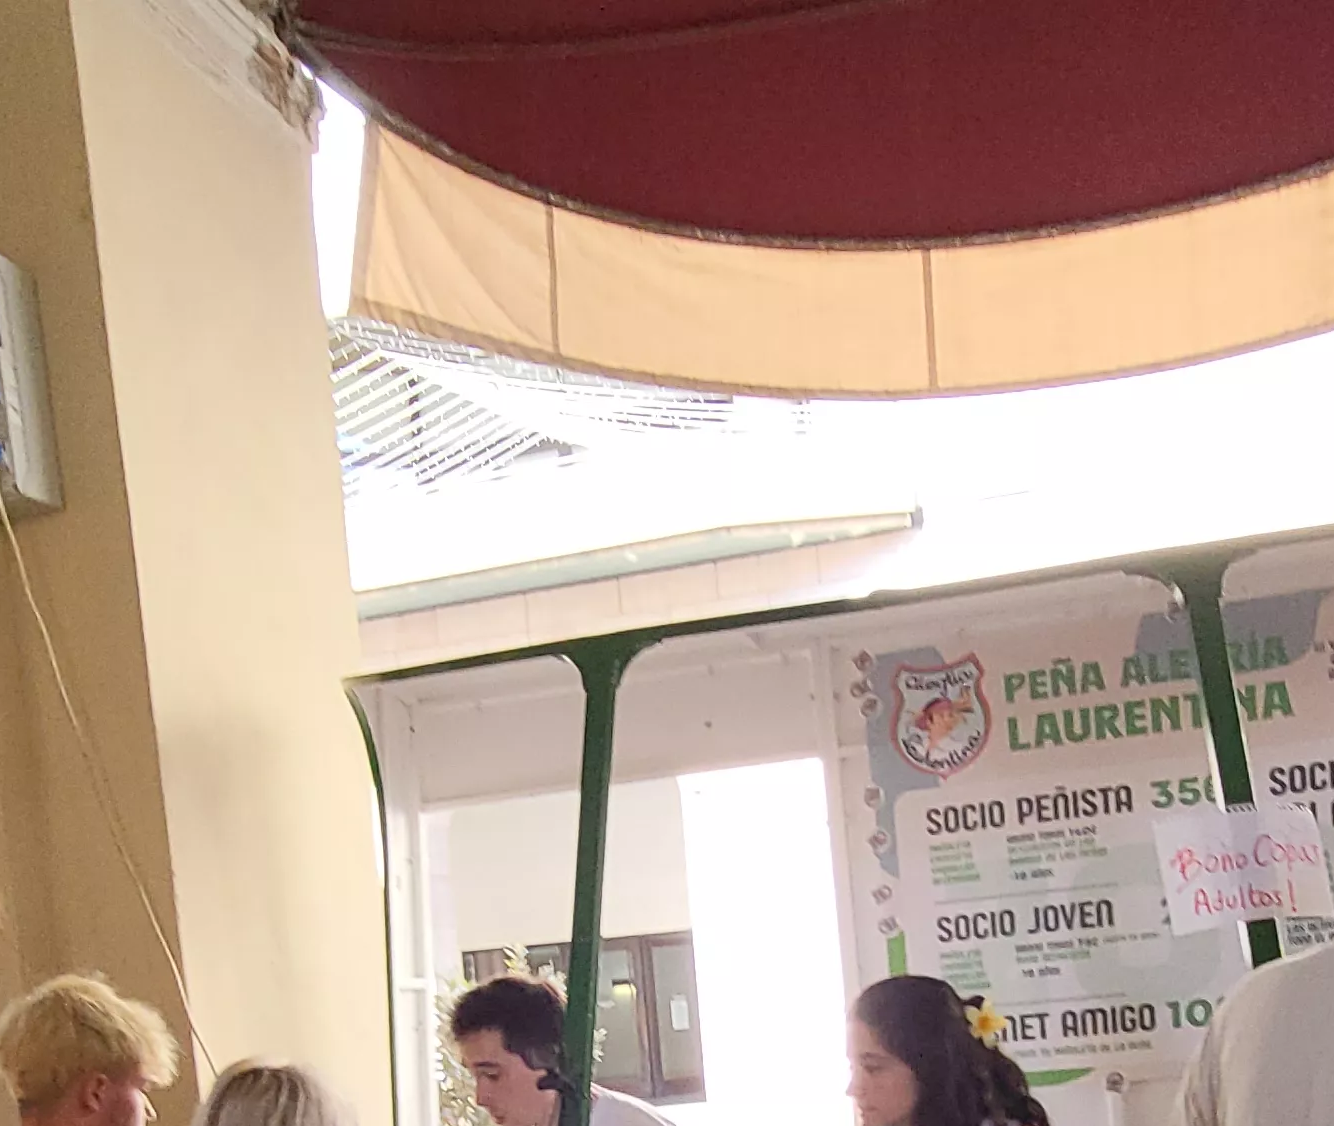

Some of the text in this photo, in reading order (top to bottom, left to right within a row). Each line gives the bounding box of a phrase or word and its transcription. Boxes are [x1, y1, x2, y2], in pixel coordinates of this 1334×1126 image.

[1004, 633, 1289, 703] PEÑA ALERÍA
[1007, 680, 1295, 751] LAURENTNA
[926, 800, 1005, 836] SOCIO
[1016, 785, 1133, 825] PEÑISTA
[937, 909, 1016, 943] SOCIO
[1027, 898, 1115, 935] JOVEN
[995, 996, 1223, 1043] NET AMIGO 10
